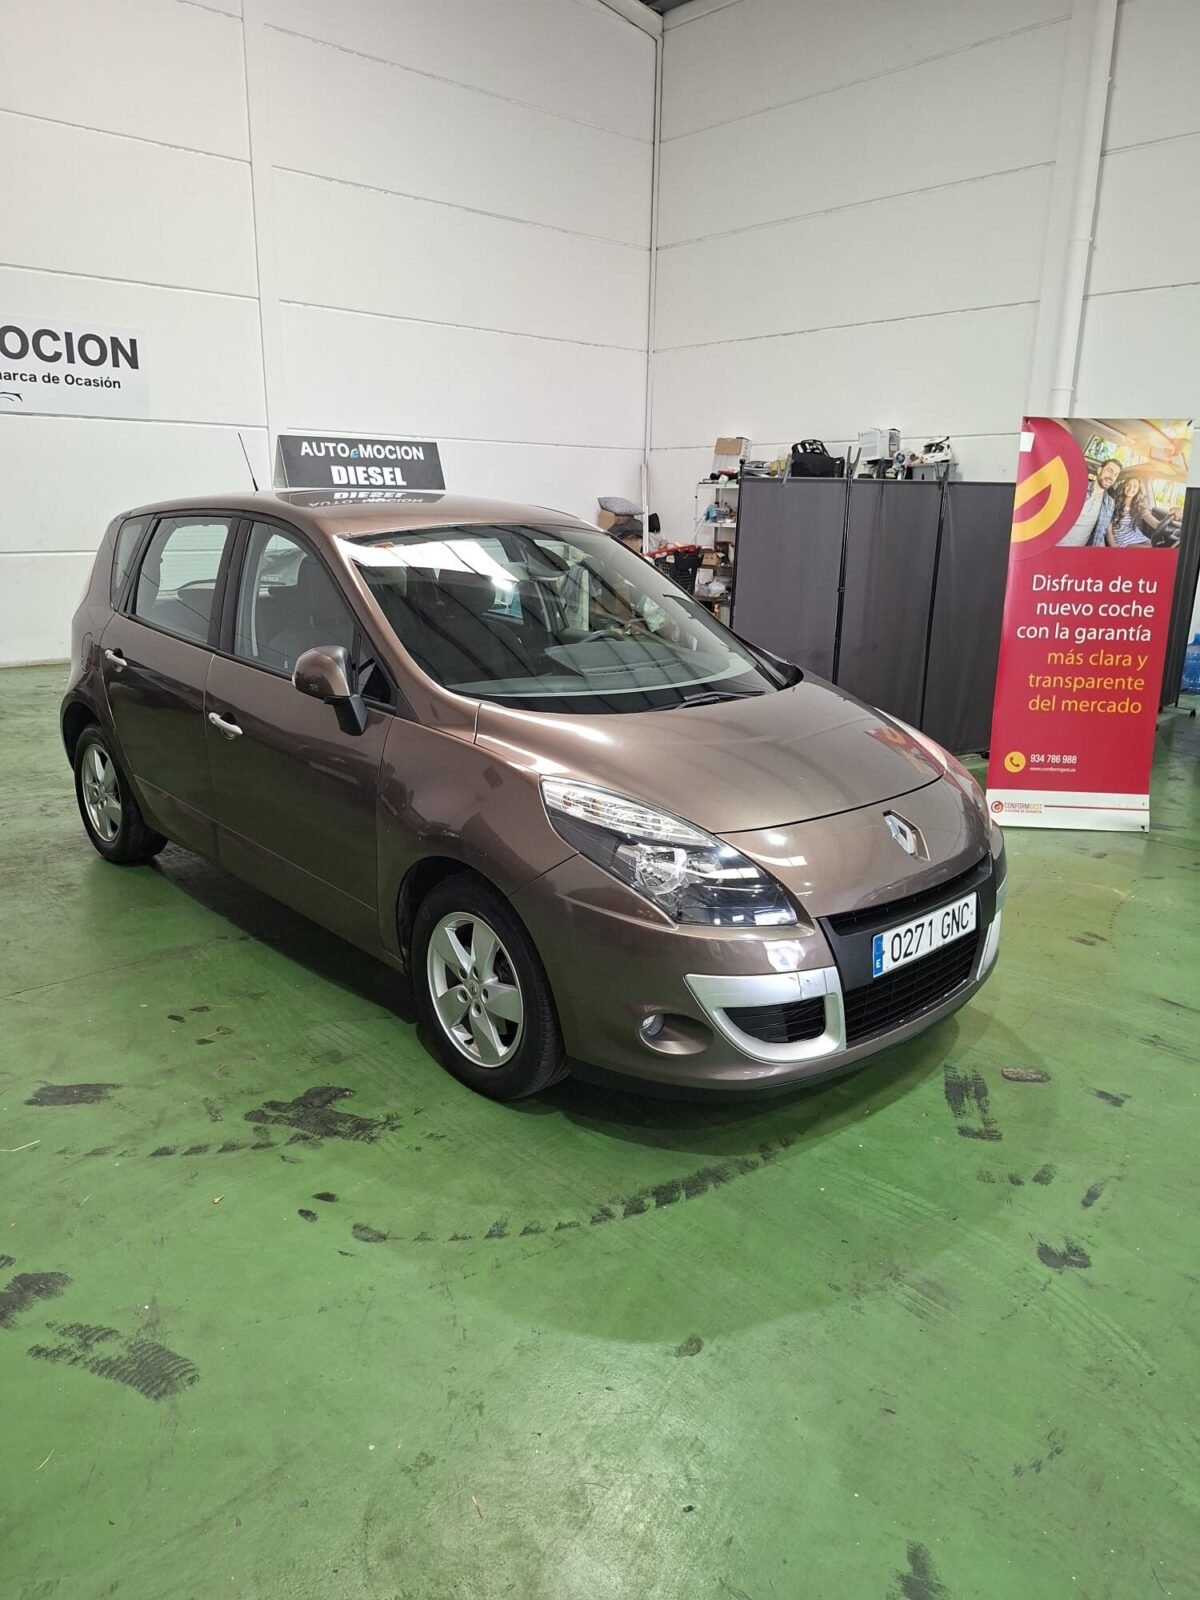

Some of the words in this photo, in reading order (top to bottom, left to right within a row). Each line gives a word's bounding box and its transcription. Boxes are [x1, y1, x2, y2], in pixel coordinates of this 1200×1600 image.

[42, 372, 60, 384] de
[64, 374, 121, 389] Ocasión
[330, 465, 407, 486] DIESEL
[1032, 574, 1103, 592] Disfruta
[1108, 575, 1133, 593] de
[1137, 578, 1157, 594] tu
[1036, 602, 1094, 616] nuevo
[1098, 600, 1155, 617] coche
[1016, 625, 1049, 639] con
[1054, 621, 1070, 640] la
[1074, 624, 1151, 644] garantía
[1047, 648, 1084, 665] más
[1088, 649, 1132, 667] clara
[1136, 655, 1149, 671] y
[1028, 673, 1145, 692] transparente
[1028, 694, 1056, 711] del
[1061, 697, 1142, 714] mercado
[1030, 753, 1045, 763] 934
[1046, 754, 1061, 764] 786
[1062, 754, 1077, 765] 988
[890, 918, 933, 963] 0271
[941, 902, 970, 940] GNC
[876, 960, 881, 968] E
